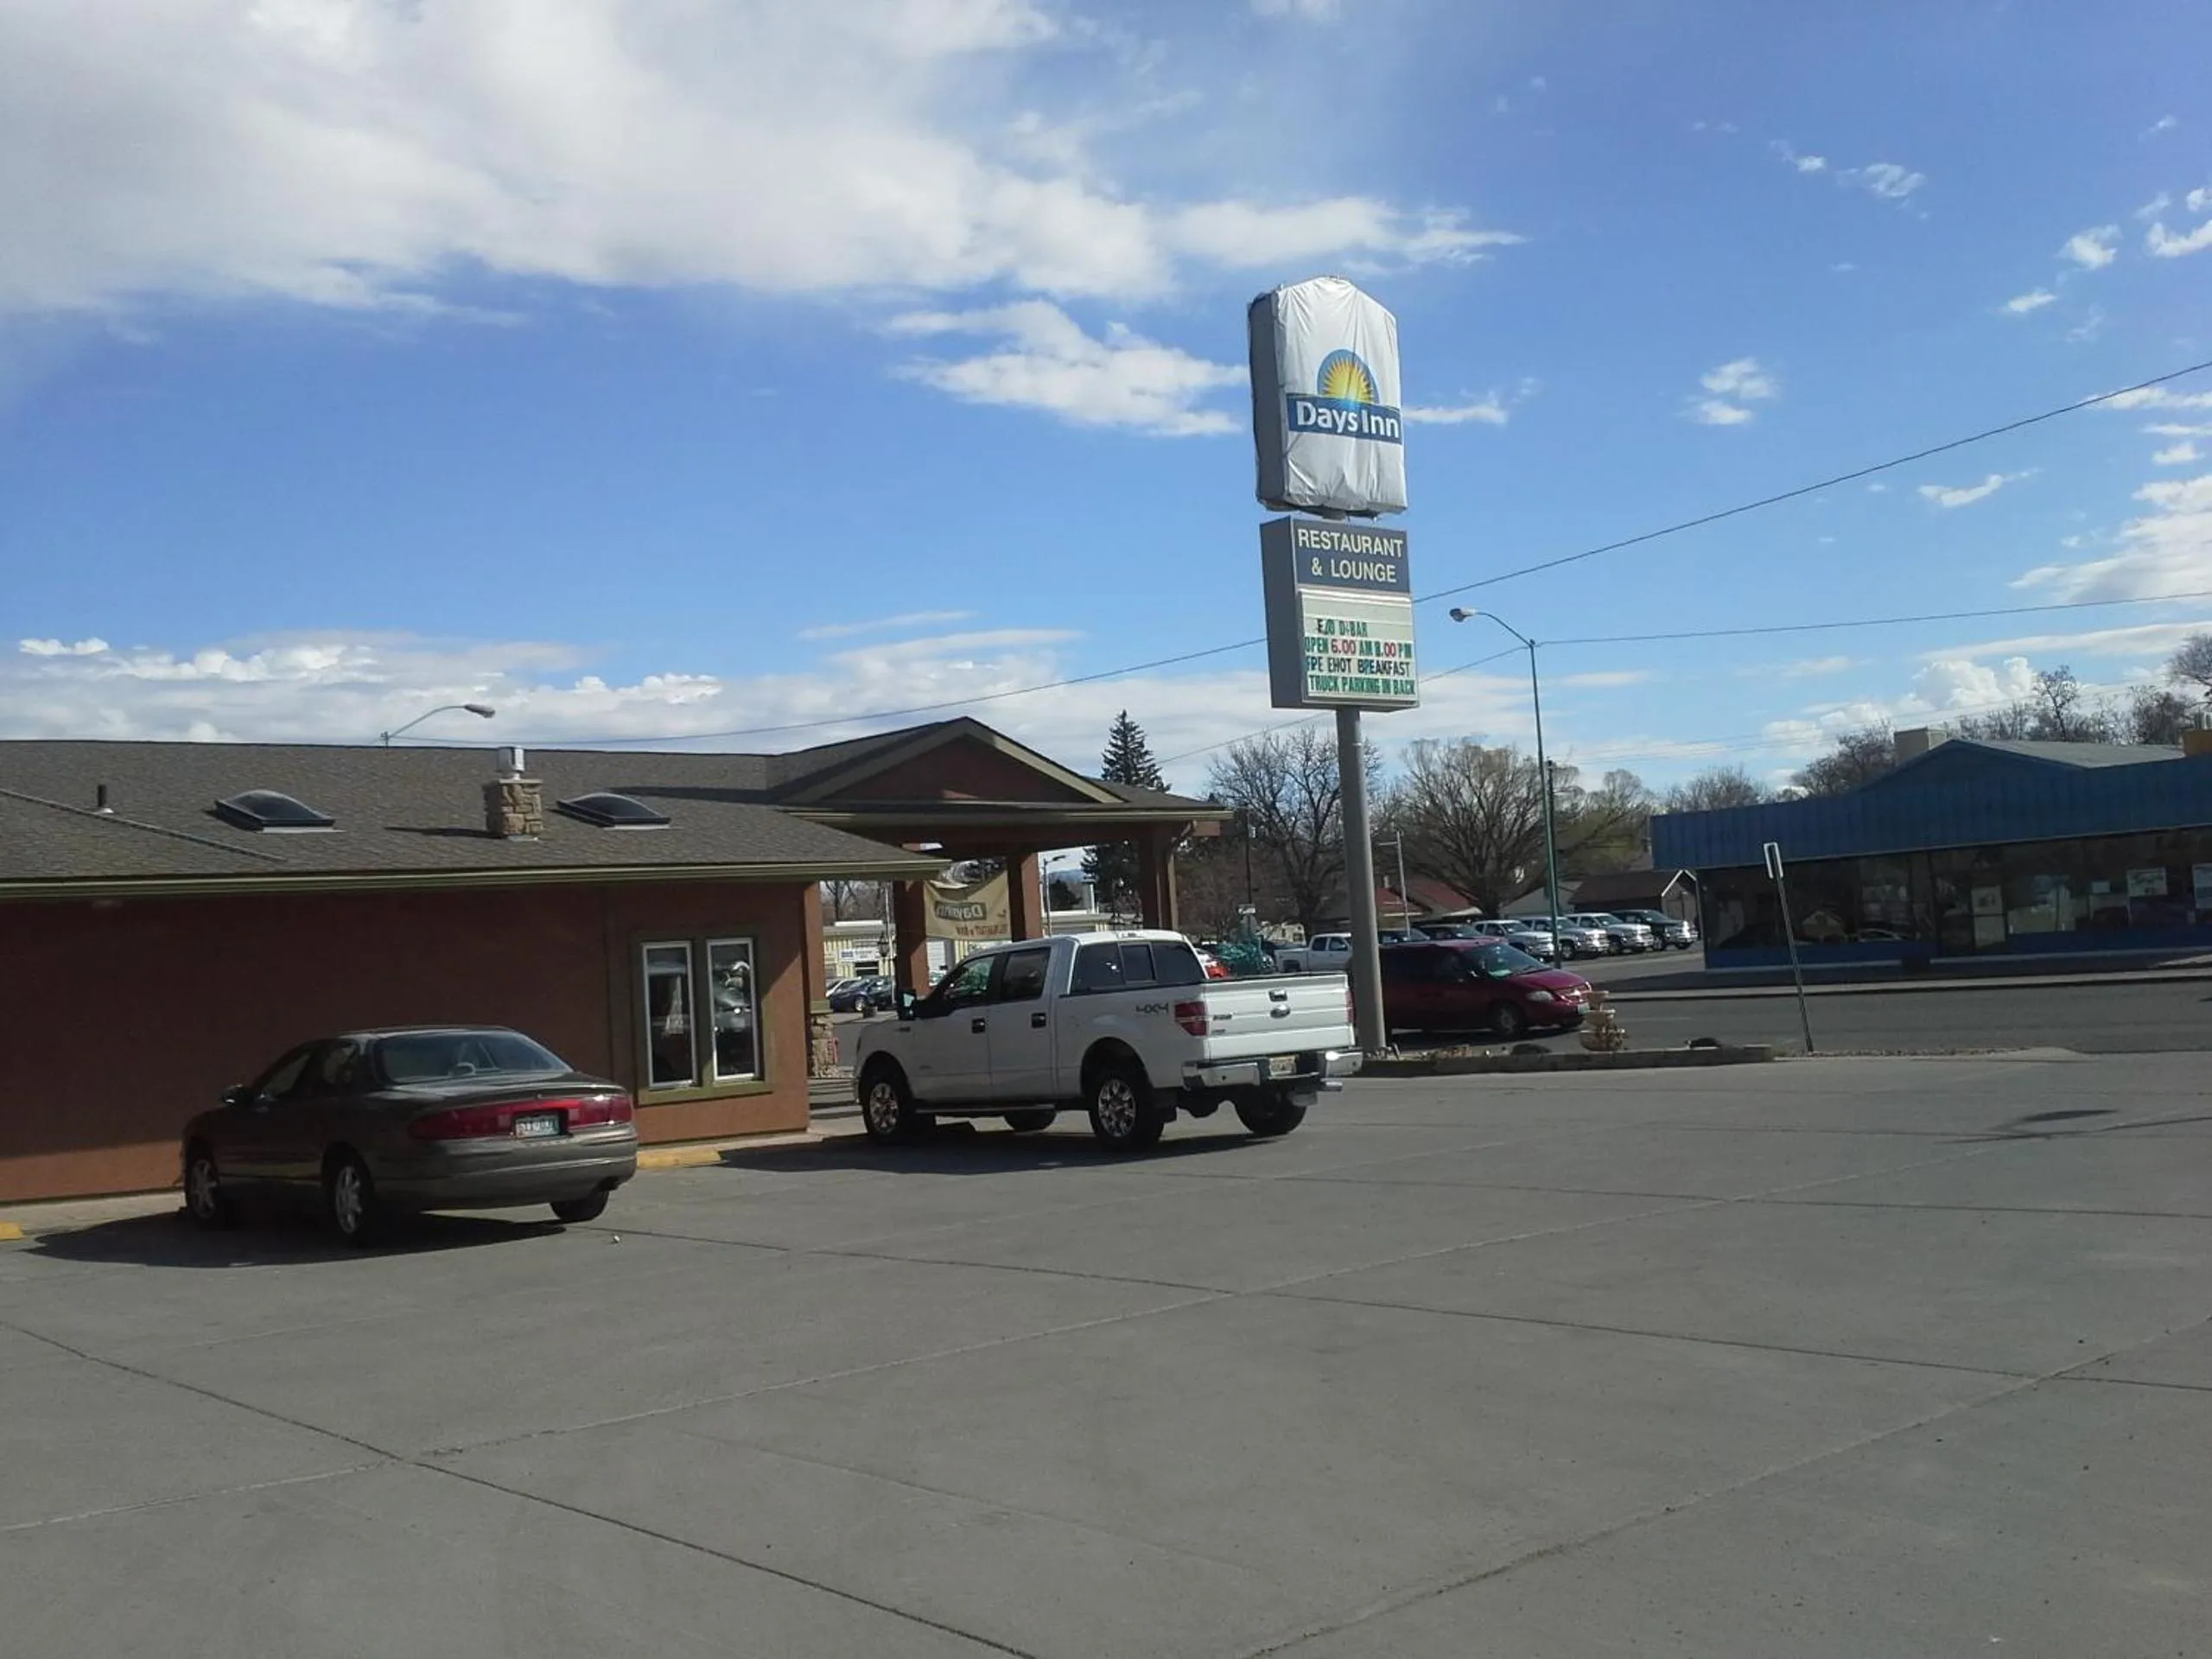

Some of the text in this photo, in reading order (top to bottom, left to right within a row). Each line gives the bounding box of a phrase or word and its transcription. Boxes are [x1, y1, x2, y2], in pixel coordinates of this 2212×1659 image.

[1297, 400, 1400, 438] Days Inn
[1298, 528, 1403, 558] RESTAURANT
[1312, 557, 1397, 583] & LOUNGE
[1305, 636, 1329, 654] OPEN
[1357, 658, 1410, 677] BREAKFAST
[1309, 674, 1339, 693] TRUCK
[1341, 677, 1380, 695] PARKING
[1393, 679, 1415, 696] BACK
